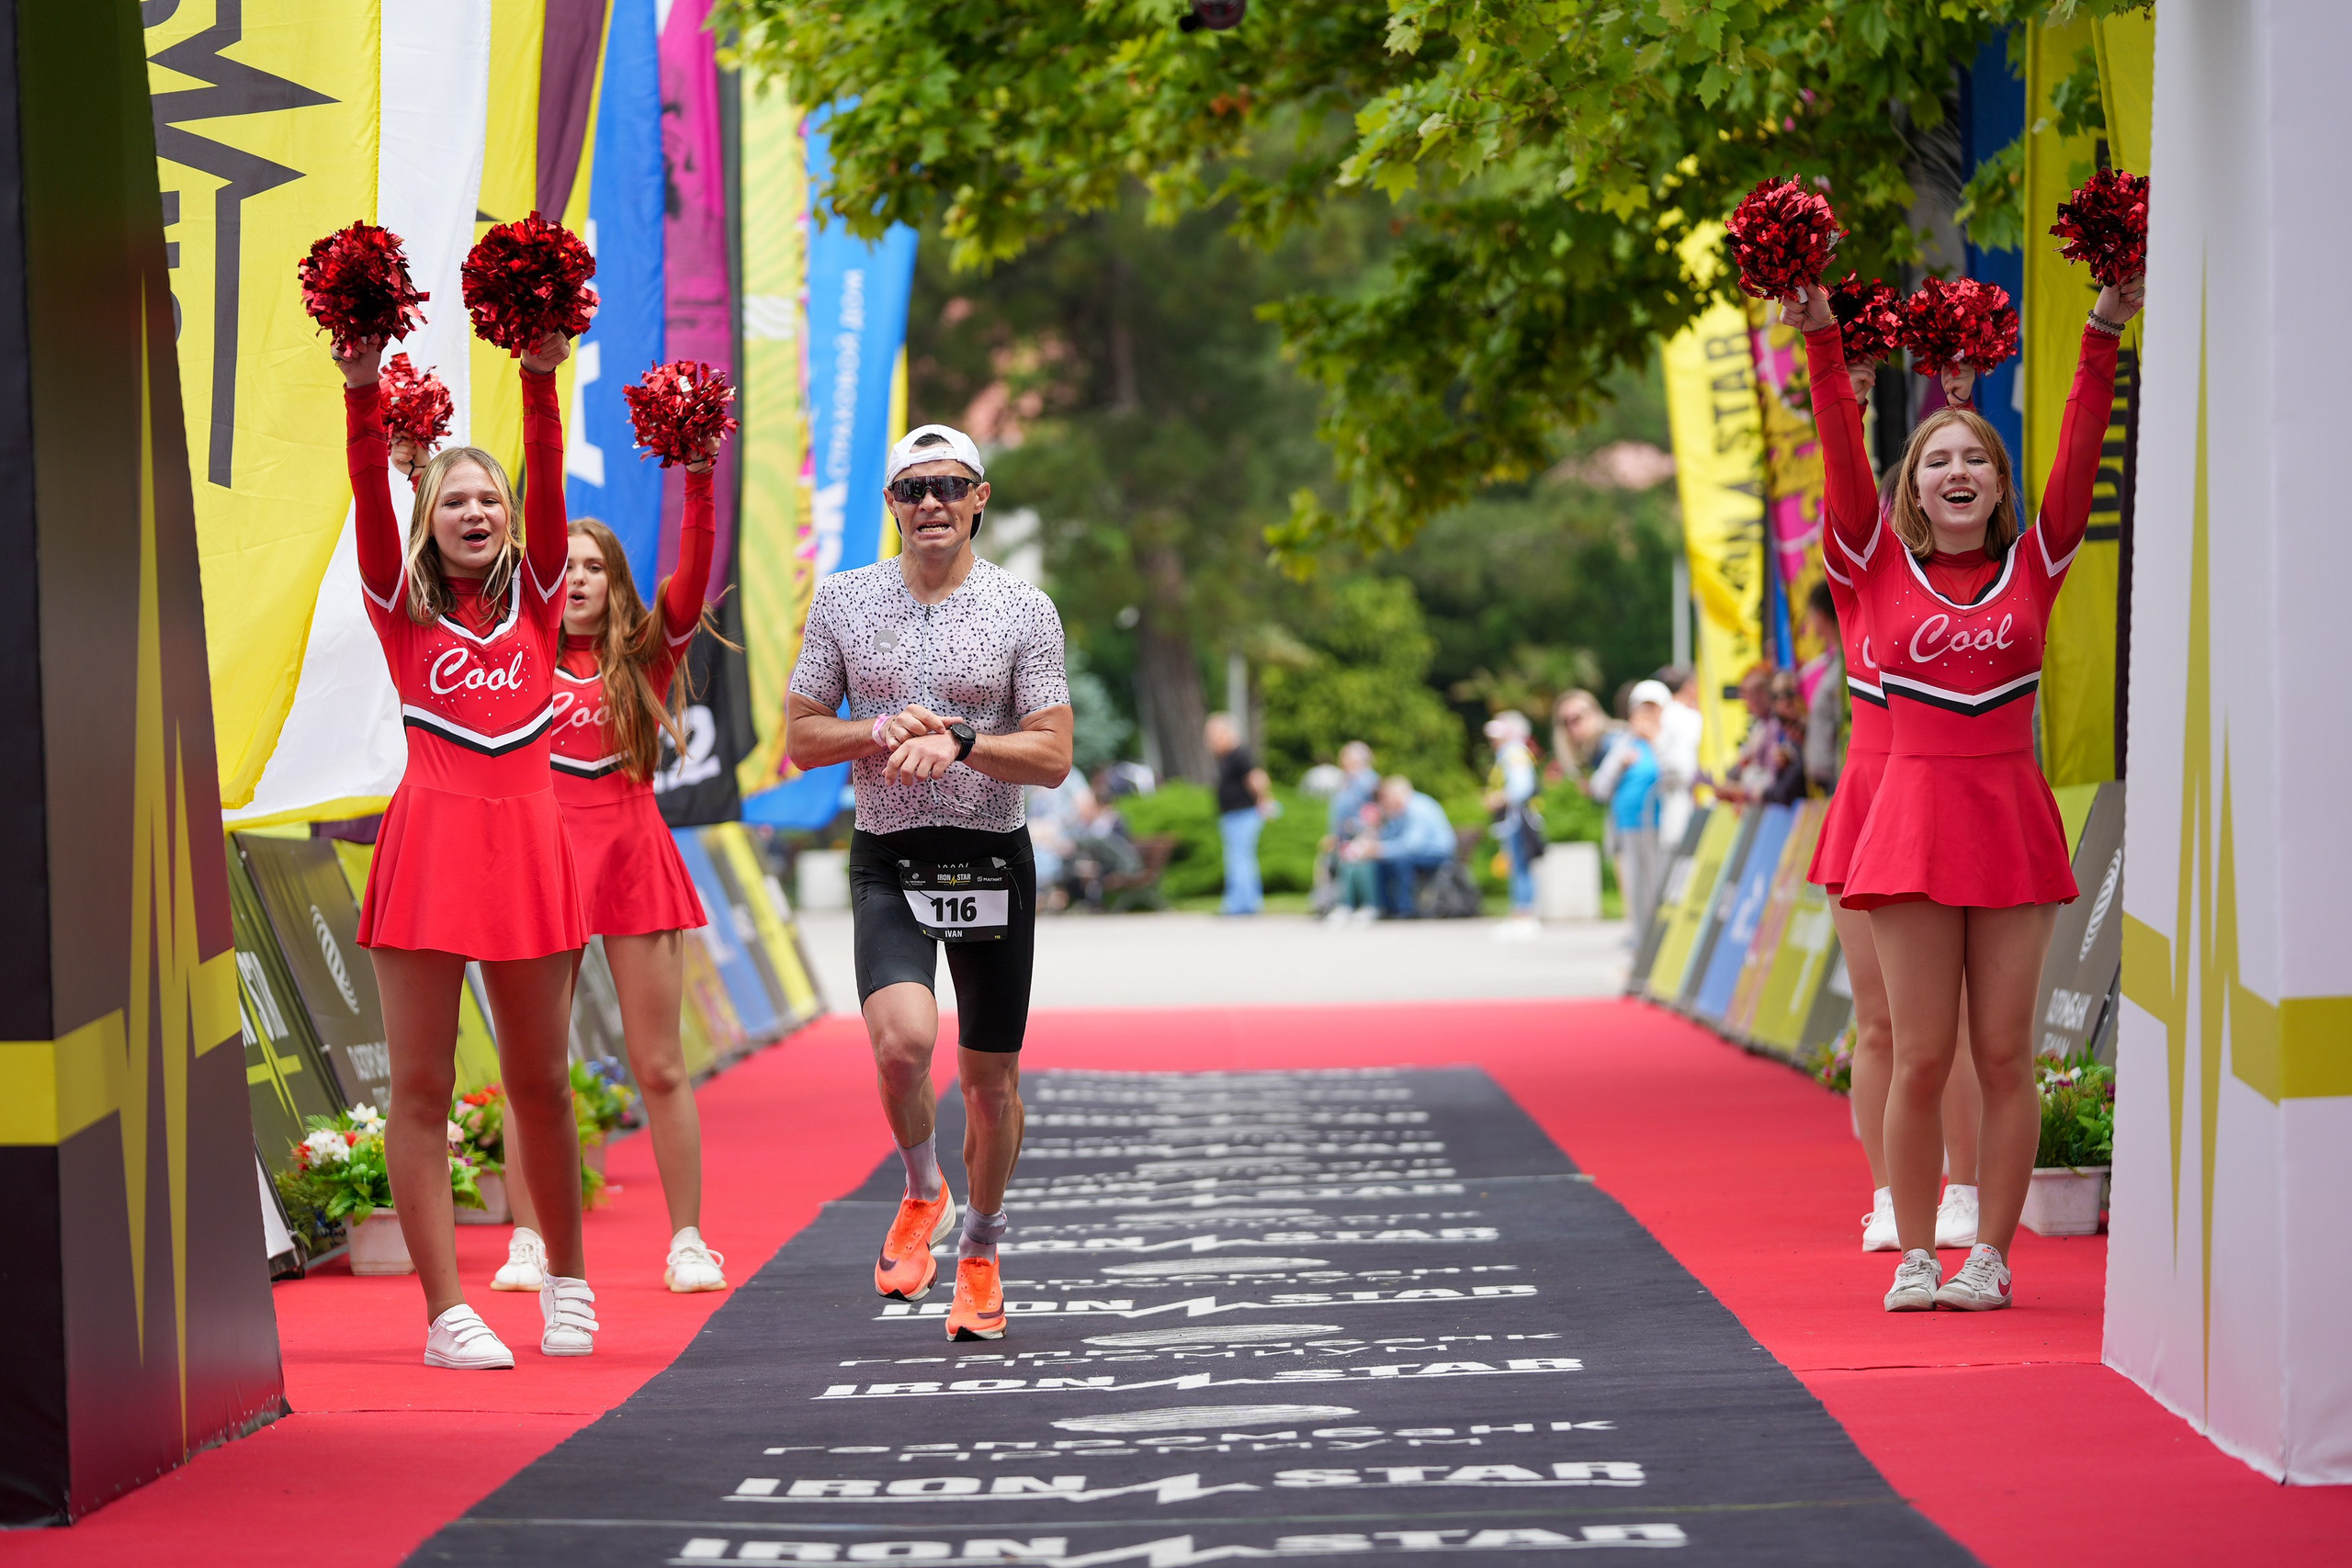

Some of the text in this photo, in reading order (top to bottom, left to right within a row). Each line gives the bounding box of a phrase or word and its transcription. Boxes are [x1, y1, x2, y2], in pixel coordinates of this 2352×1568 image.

[1908, 613, 2014, 663] Cool
[429, 648, 523, 694] Cool
[551, 692, 617, 737] Coo
[930, 897, 978, 922] 116
[944, 930, 963, 938] IVAN
[1263, 1227, 1499, 1242] STAR
[1270, 1285, 1538, 1302] STAR
[823, 1359, 1582, 1396] IRON STAR
[736, 1461, 1645, 1497] IRON STAR
[681, 1523, 1687, 1562] IRON STAR
